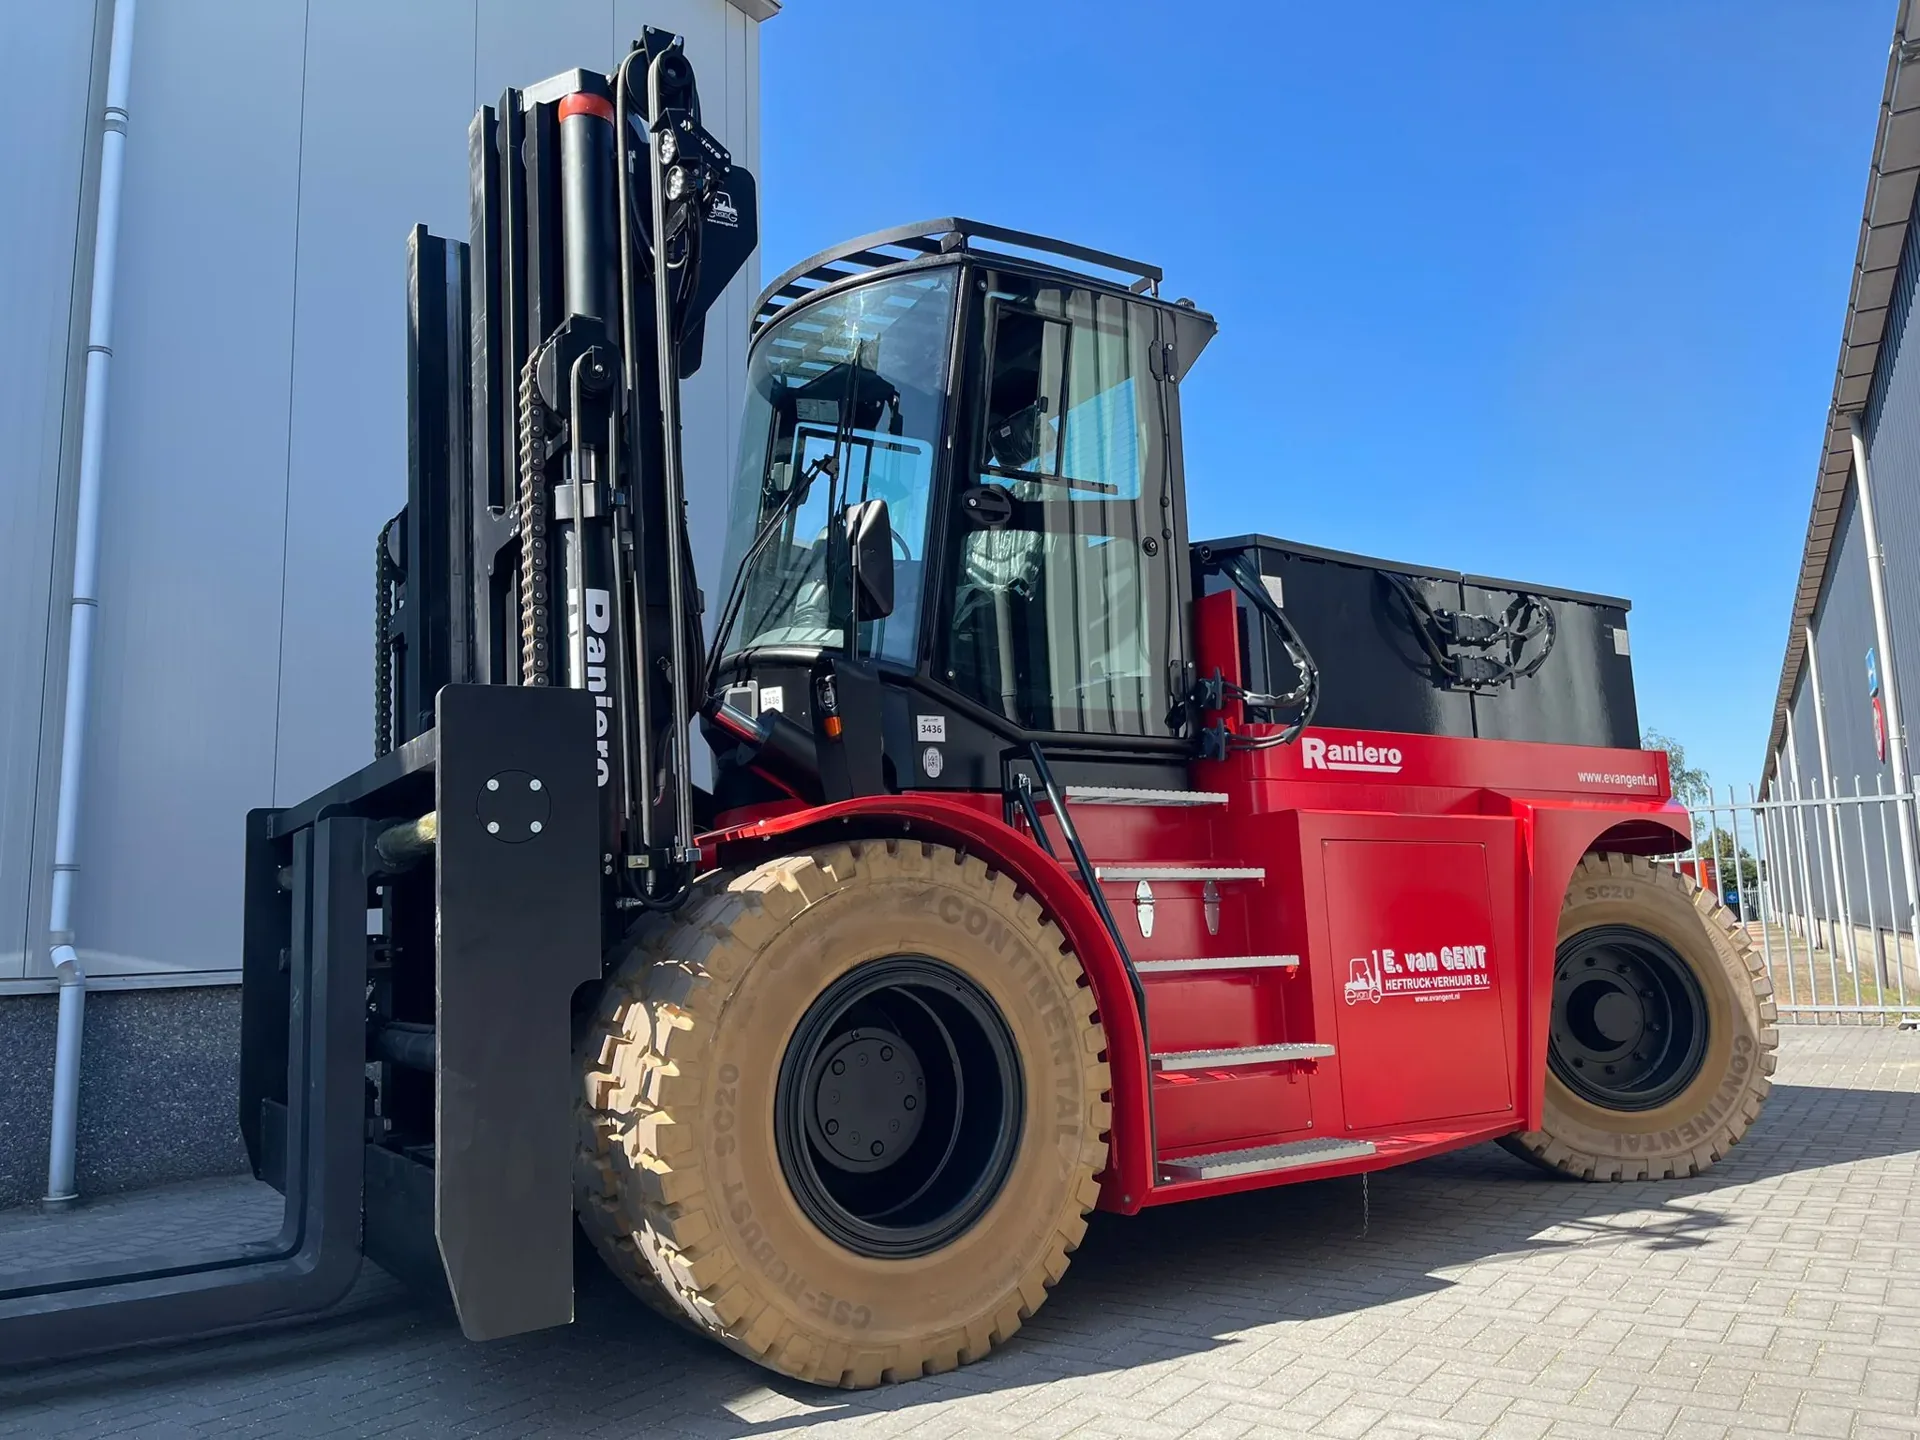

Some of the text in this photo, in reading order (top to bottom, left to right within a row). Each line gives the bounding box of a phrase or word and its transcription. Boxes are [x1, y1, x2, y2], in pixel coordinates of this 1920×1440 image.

[921, 724, 942, 733] 3436
[1301, 737, 1402, 770] Raniero
[1578, 772, 1657, 788] www.evangent.nl
[1585, 884, 1635, 900] SC20
[1382, 945, 1487, 974] E. van GENT
[1385, 973, 1490, 991] HEFTRUCK-VERHUUR B.V.
[1414, 992, 1460, 1003] www.evangent.nl
[938, 895, 1080, 1145] CONTINENTAL
[1607, 1034, 1752, 1153] CONTINENTAL
[712, 1062, 740, 1158] SC20
